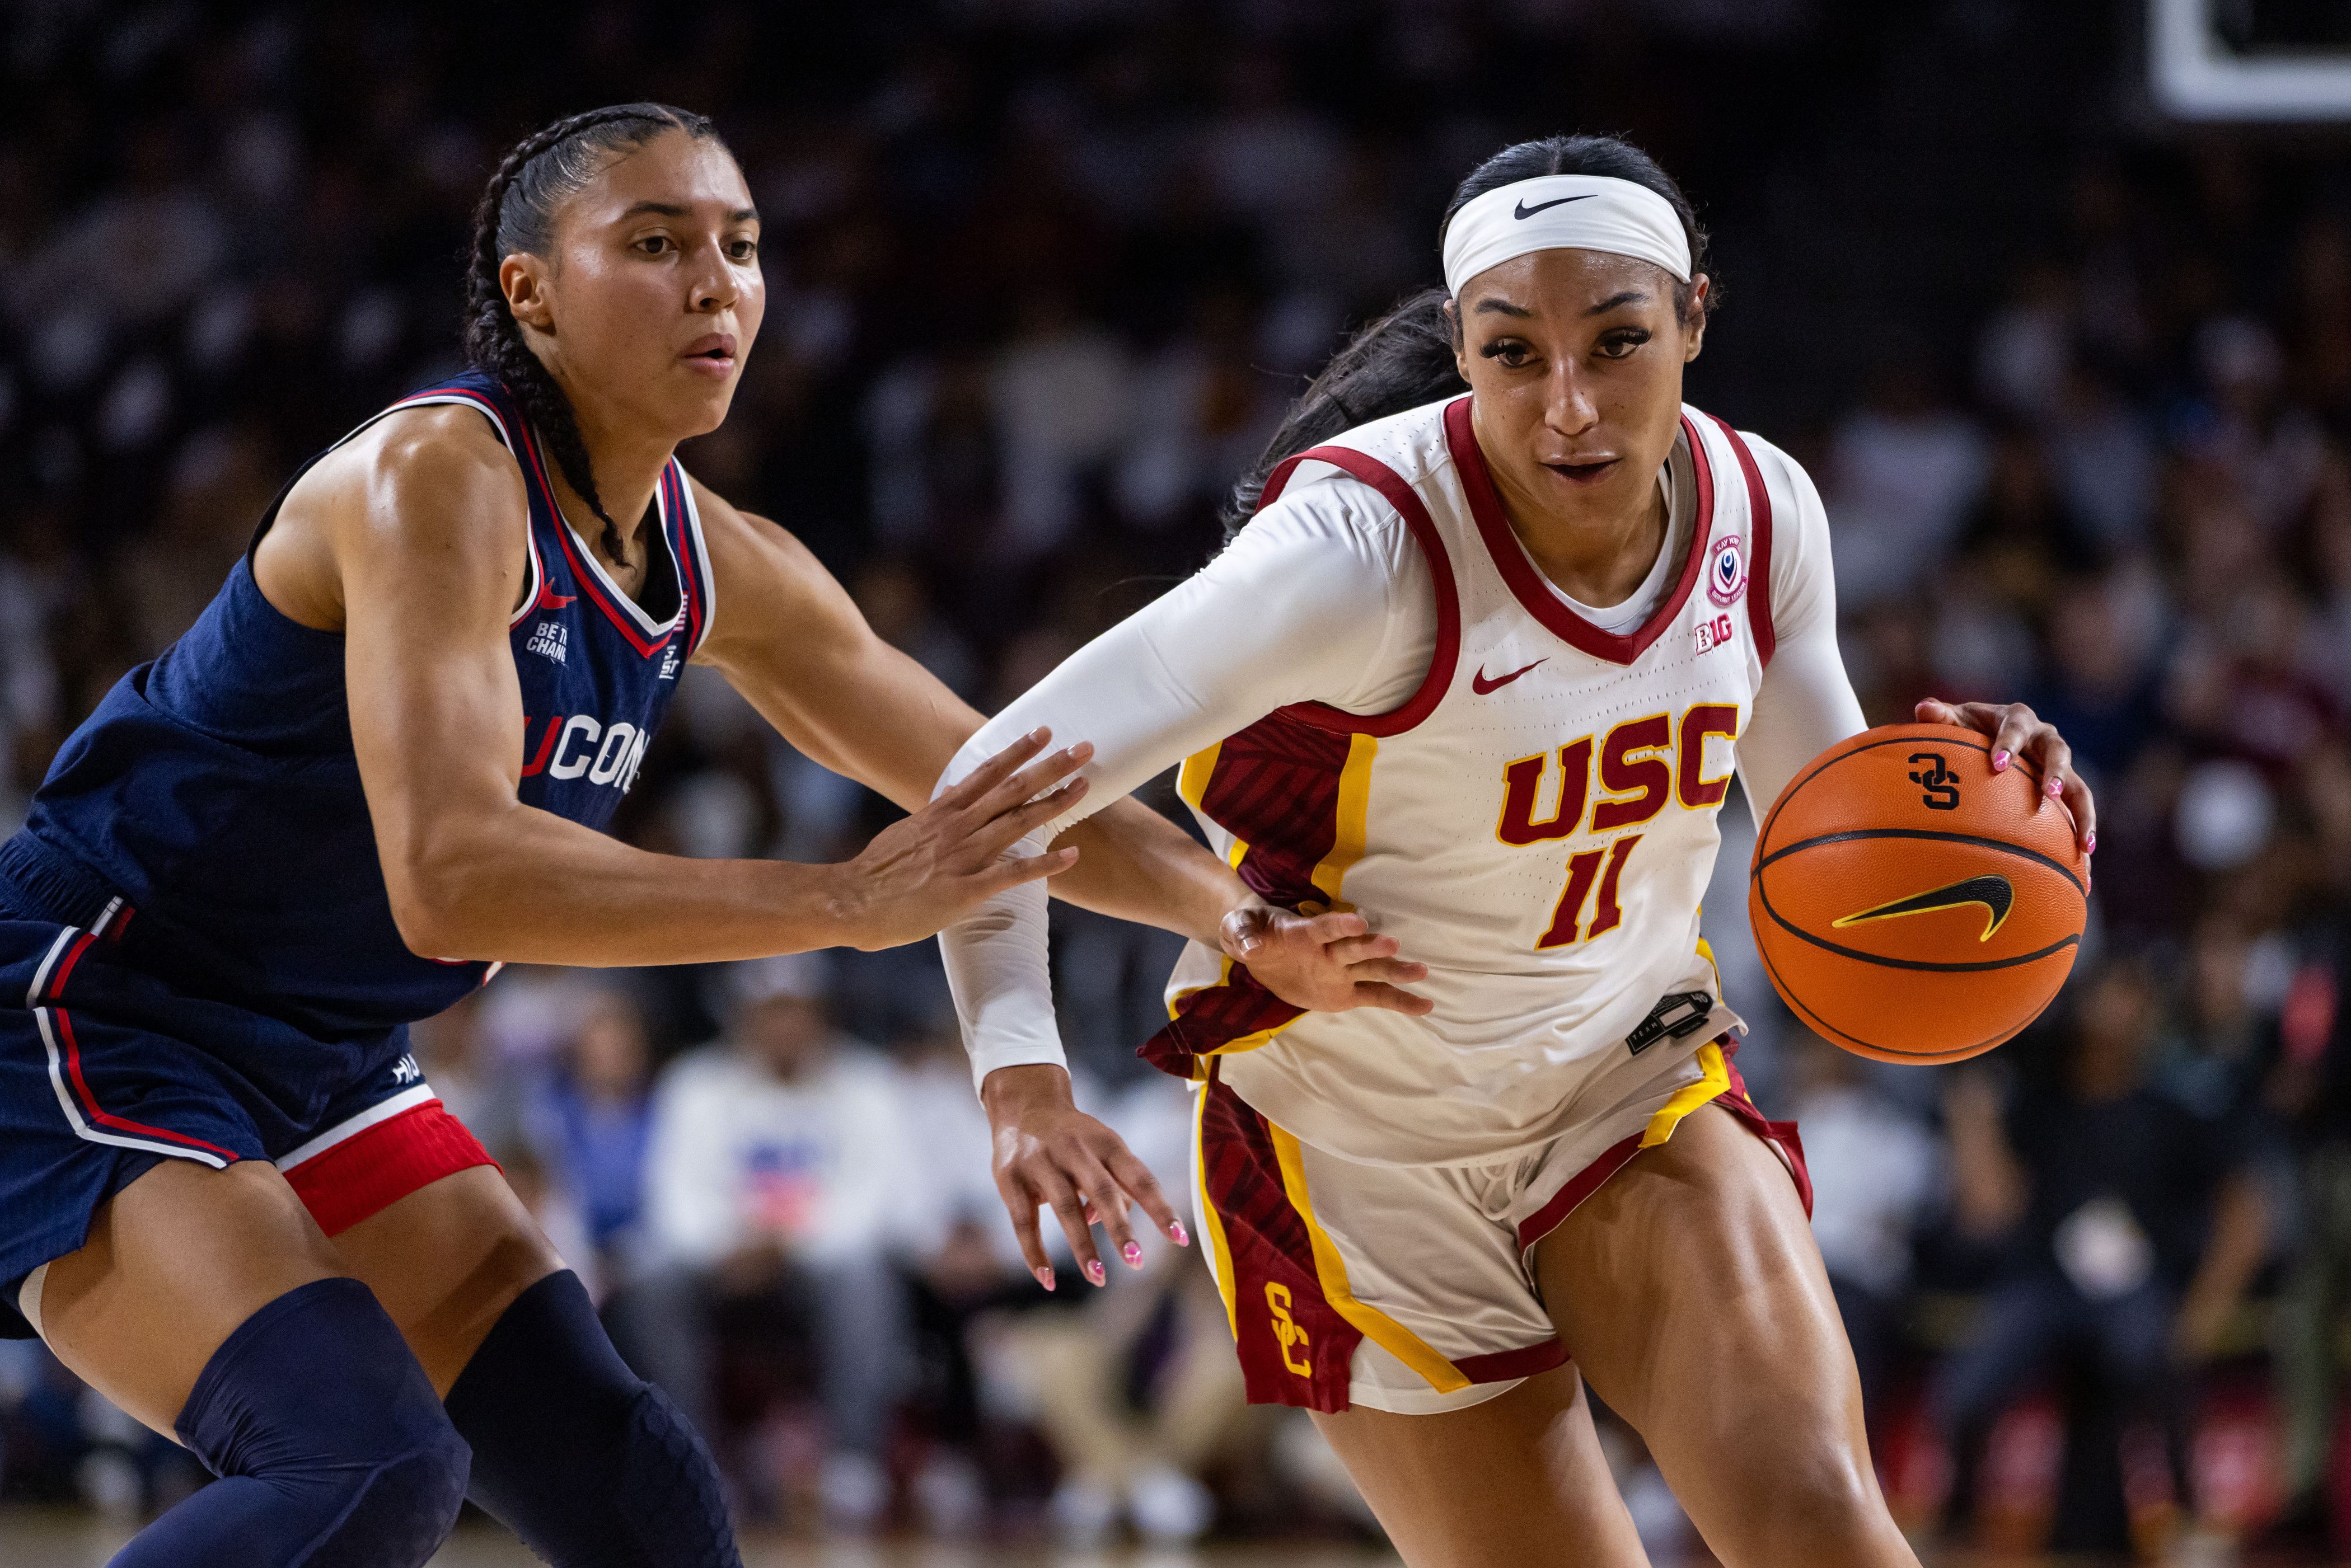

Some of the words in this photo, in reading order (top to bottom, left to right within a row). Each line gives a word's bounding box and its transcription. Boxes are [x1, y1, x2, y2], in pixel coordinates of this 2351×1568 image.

[536, 622, 559, 640] BE
[1495, 703, 1739, 848] USC
[1534, 833, 1646, 951] 11
[1265, 1281, 1312, 1378] SC
